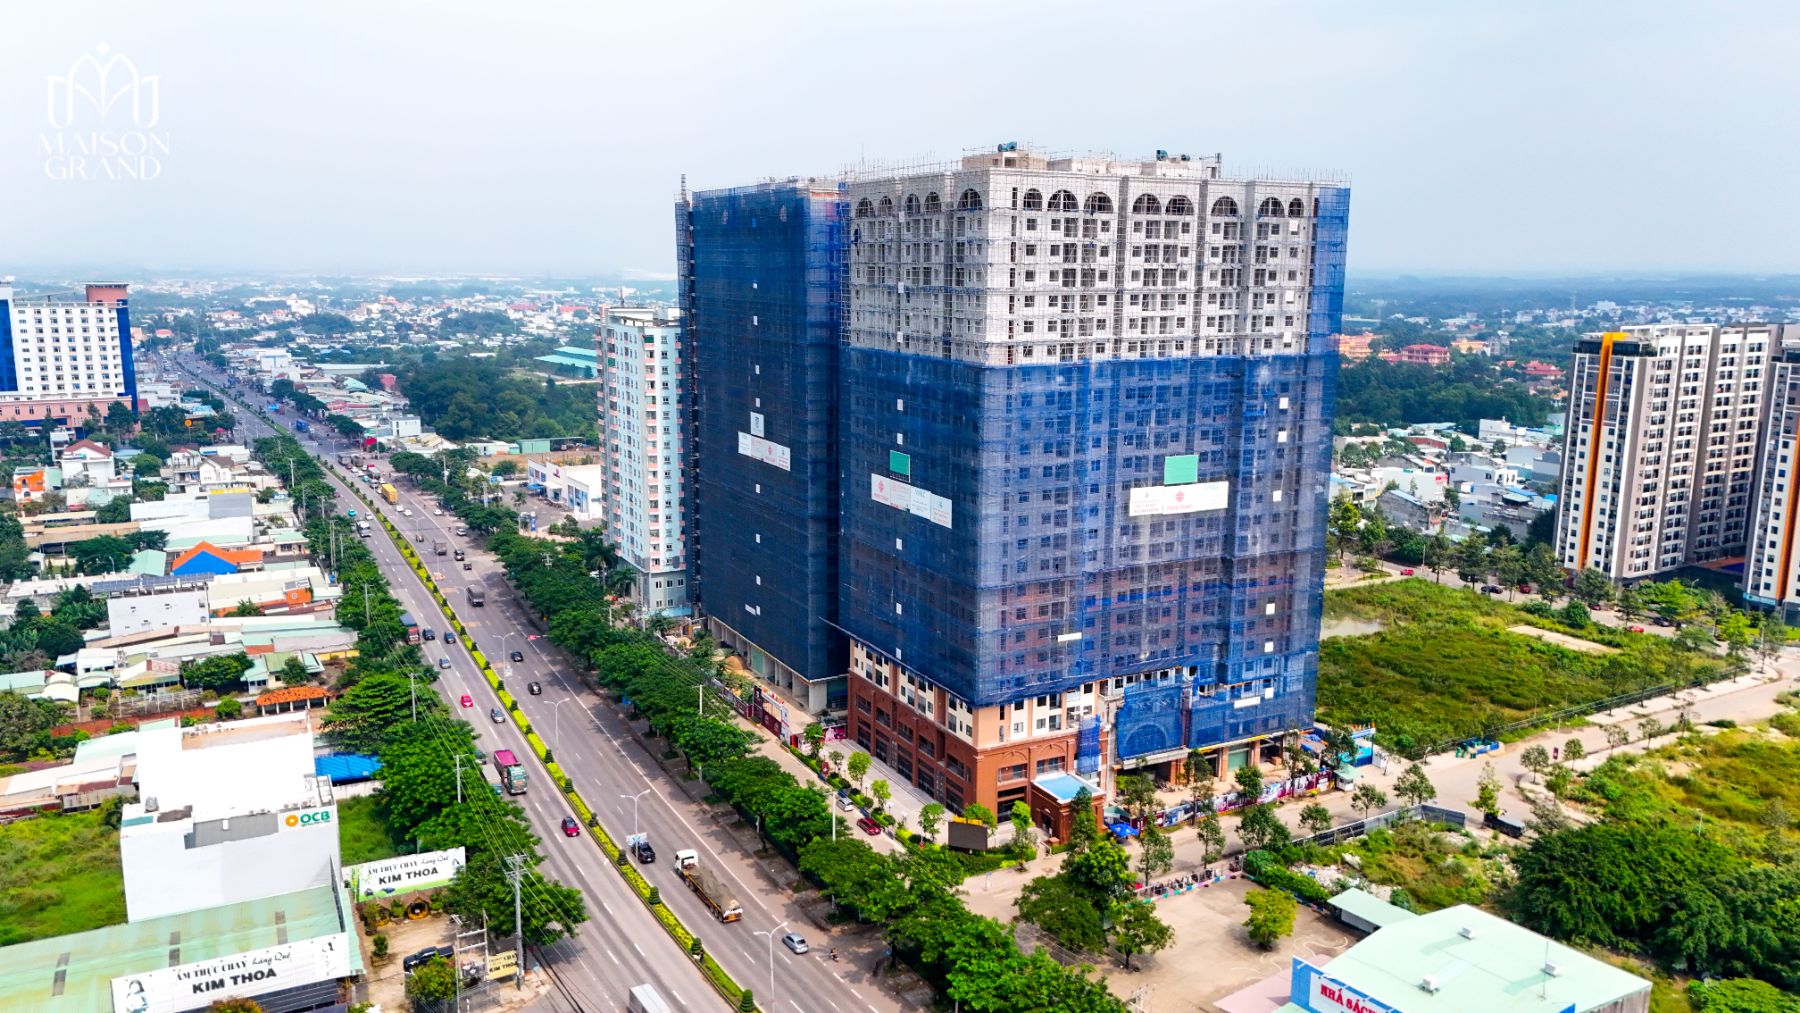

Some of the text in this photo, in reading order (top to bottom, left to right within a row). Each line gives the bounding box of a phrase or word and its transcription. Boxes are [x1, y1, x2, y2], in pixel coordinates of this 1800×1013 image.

[300, 811, 330, 824] OCB
[378, 867, 439, 885] KIM THOA
[192, 968, 277, 994] KIM THOA
